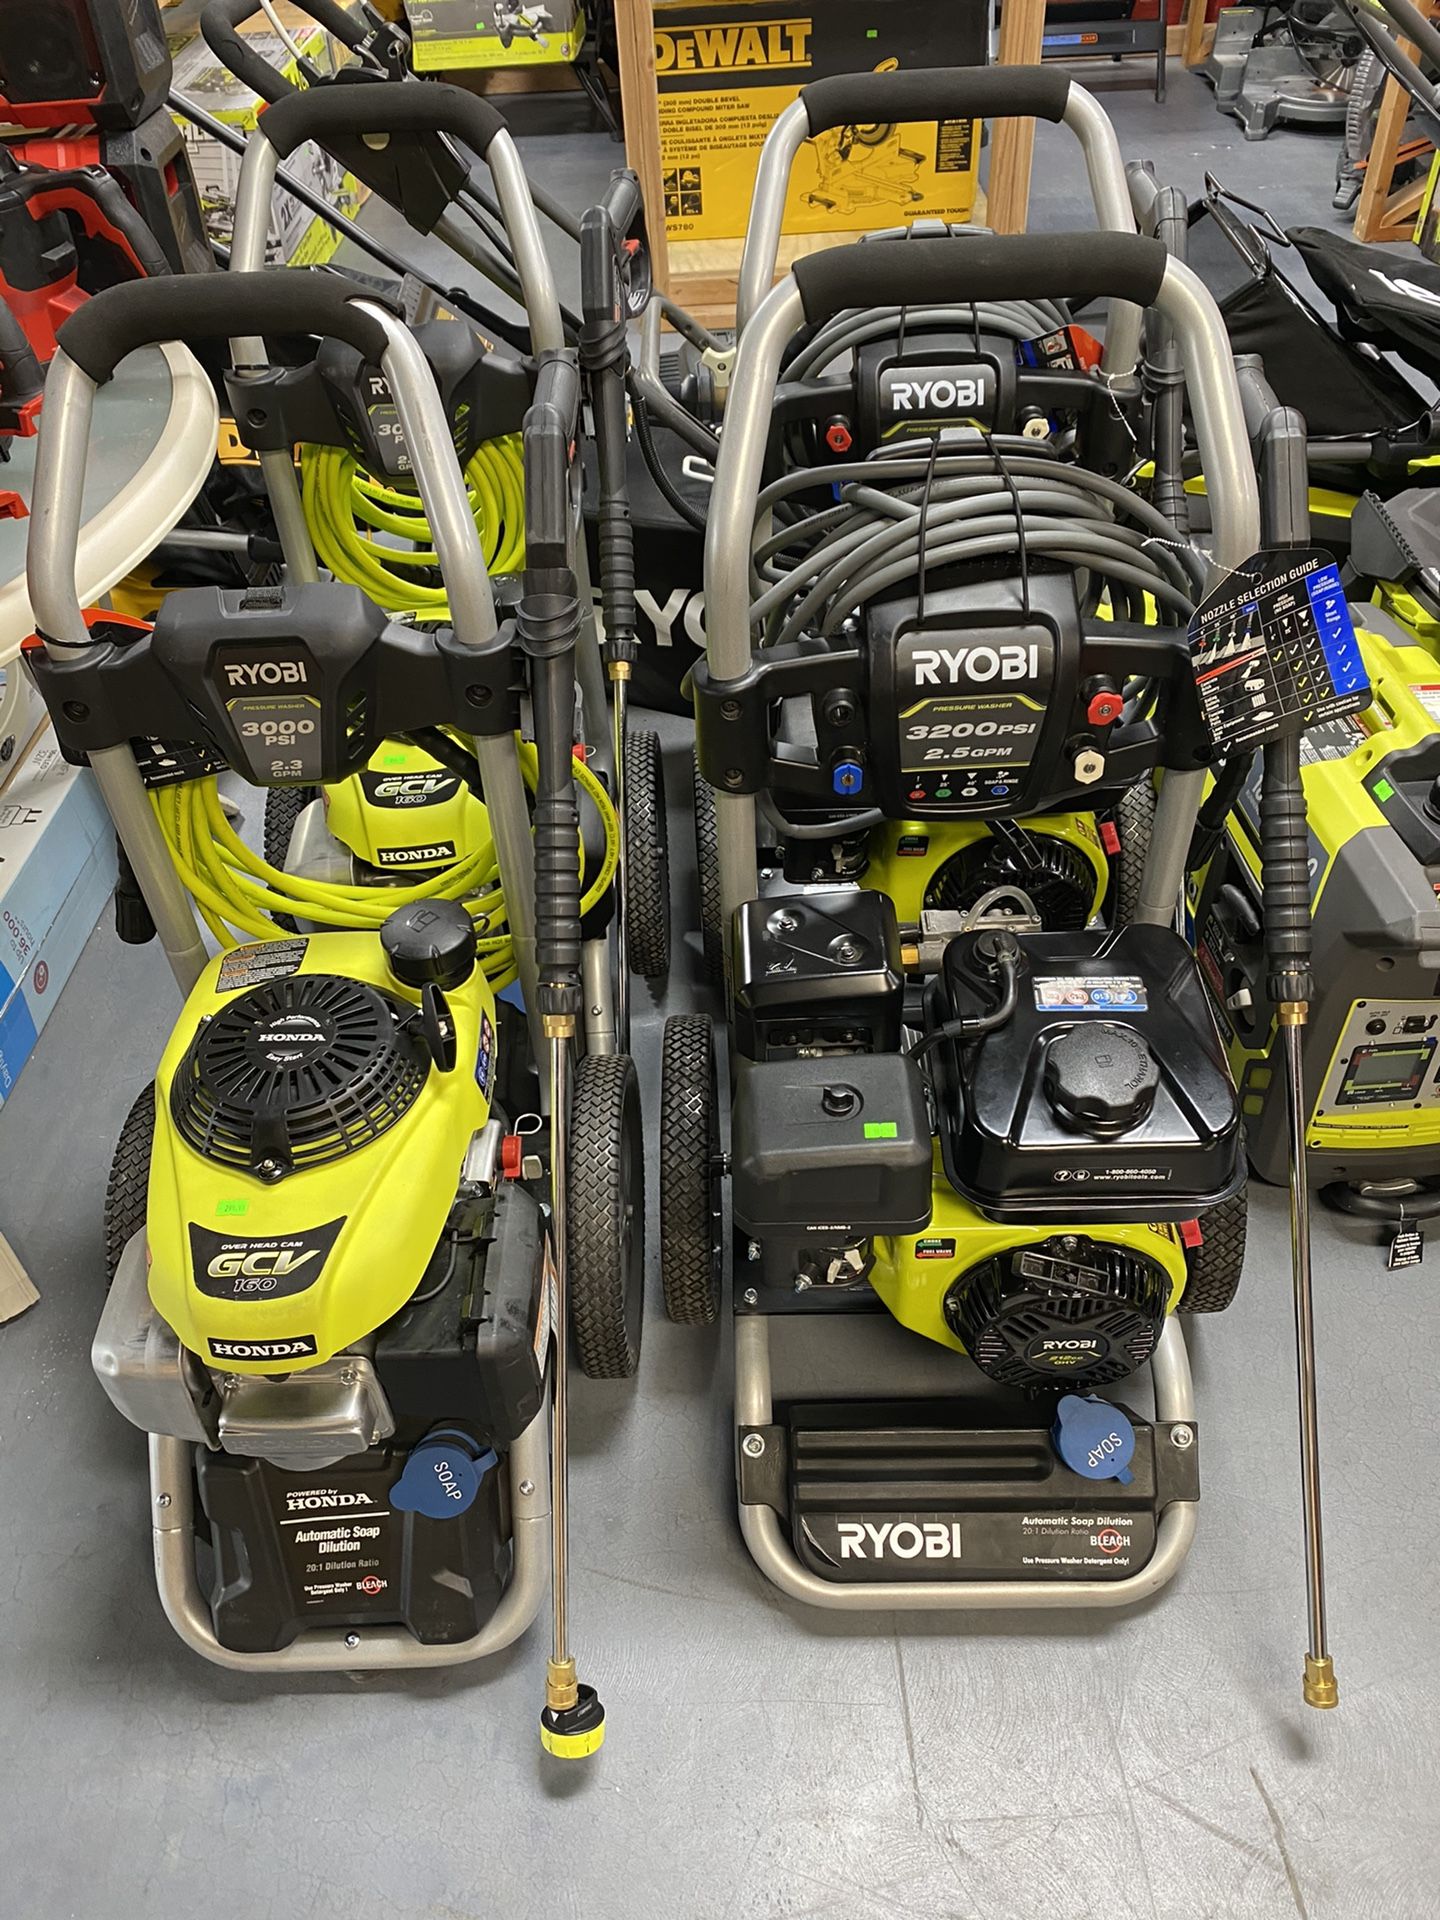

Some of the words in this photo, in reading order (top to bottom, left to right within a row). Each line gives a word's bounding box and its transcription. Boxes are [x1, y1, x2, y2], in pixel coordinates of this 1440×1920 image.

[678, 105, 714, 113] COMPOUND
[890, 379, 985, 410] RYOBI
[1201, 598, 1237, 624] NOZZLE
[1237, 573, 1288, 604] SELECTION
[1289, 558, 1320, 580] GUIDE
[912, 645, 1038, 685] RYOBI
[224, 661, 307, 686] RYOBI
[932, 704, 976, 712] PRESSURE
[977, 702, 1012, 710] WASHER
[241, 719, 315, 737] 3000
[265, 735, 296, 746] PSI
[271, 760, 303, 771] 2.3
[375, 778, 457, 797] GCV
[395, 794, 426, 804] 160
[380, 846, 453, 862] HONDA
[258, 1033, 326, 1042] HONDA
[207, 1250, 321, 1278] GCV
[233, 1277, 278, 1293] 160
[212, 1341, 313, 1357] HONDA
[1043, 1340, 1097, 1350] RYOBI
[1087, 1432, 1122, 1467] SOAP
[434, 1461, 462, 1500] SOAP
[286, 1489, 327, 1498] POWERED
[286, 1493, 374, 1511] HONDA
[1022, 1517, 1069, 1525] Automatic
[1071, 1517, 1094, 1527] Soap
[1097, 1517, 1133, 1526] Dilution
[295, 1527, 351, 1543] Automatic
[353, 1526, 380, 1538] Soap
[1041, 1527, 1069, 1535] Dilution
[319, 1540, 360, 1553] Dilution
[837, 1522, 961, 1559] RYOBI
[1090, 1535, 1131, 1546] BLEACH
[306, 1563, 323, 1573] 20:1
[325, 1560, 356, 1571] Dilution
[358, 1558, 379, 1567] Ratio
[1035, 1556, 1060, 1564] Pressure
[1060, 1556, 1083, 1564] Washer
[1084, 1558, 1112, 1566] Detergent
[1114, 1557, 1129, 1566] Only!
[356, 1579, 388, 1590] BLEACH
